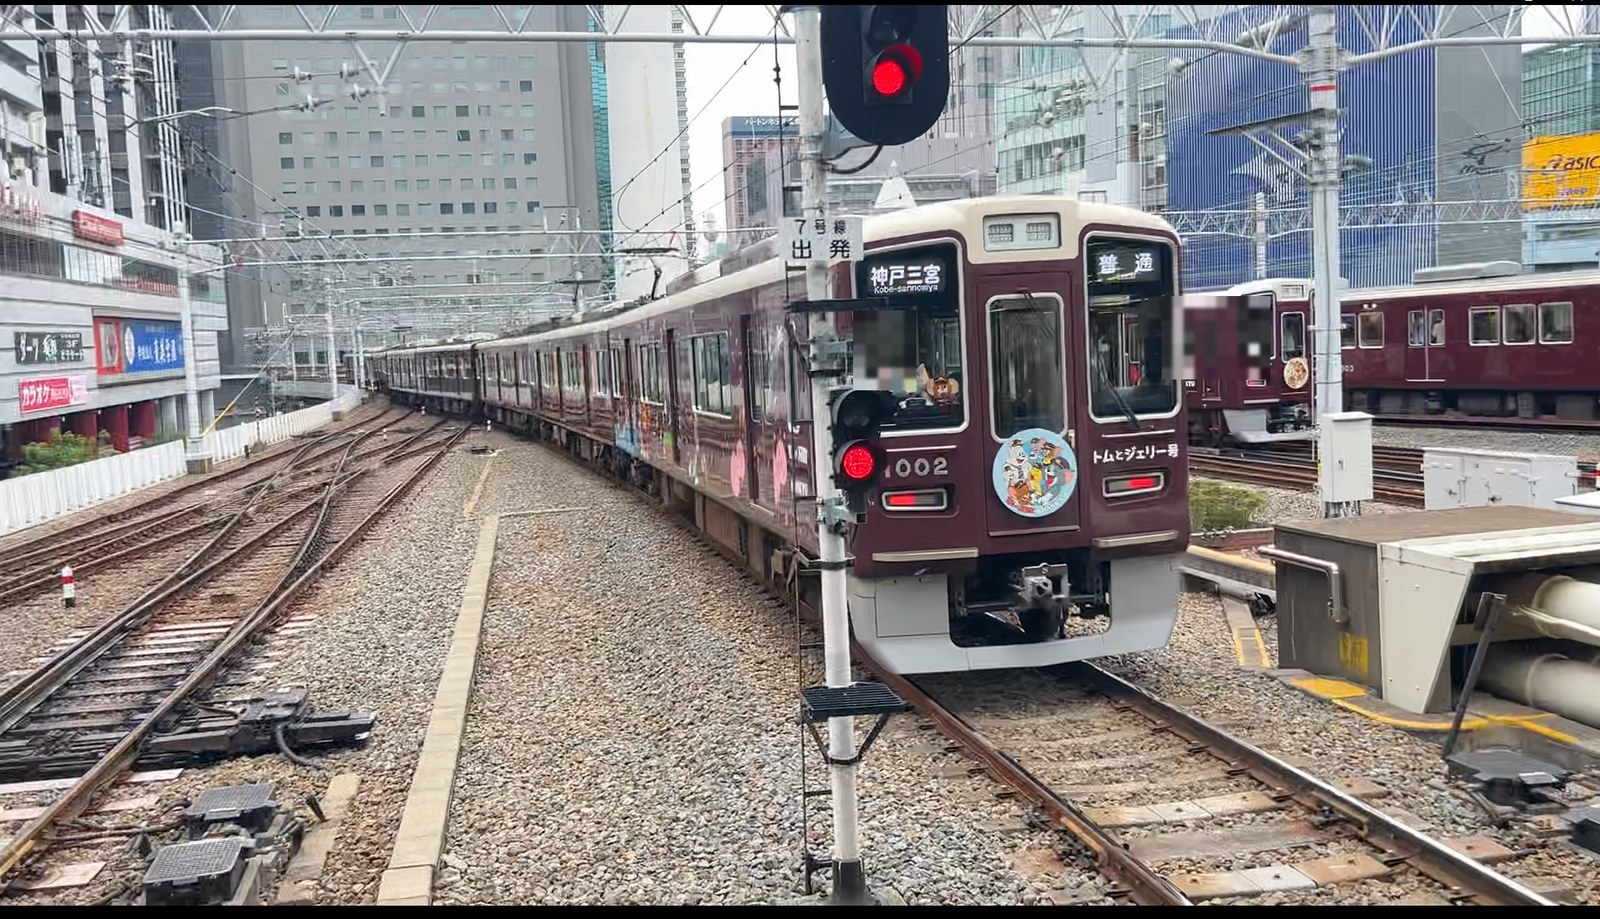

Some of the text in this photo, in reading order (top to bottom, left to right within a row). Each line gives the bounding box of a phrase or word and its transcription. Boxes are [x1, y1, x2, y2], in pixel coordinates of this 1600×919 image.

[794, 219, 847, 235] 7号線
[792, 239, 850, 259] 出発
[1099, 253, 1154, 274] 普通
[871, 264, 941, 286] 神戸三宮
[21, 383, 50, 407] カラオケ
[1093, 443, 1179, 464] トムとジェリー号
[884, 457, 948, 478] 1002
